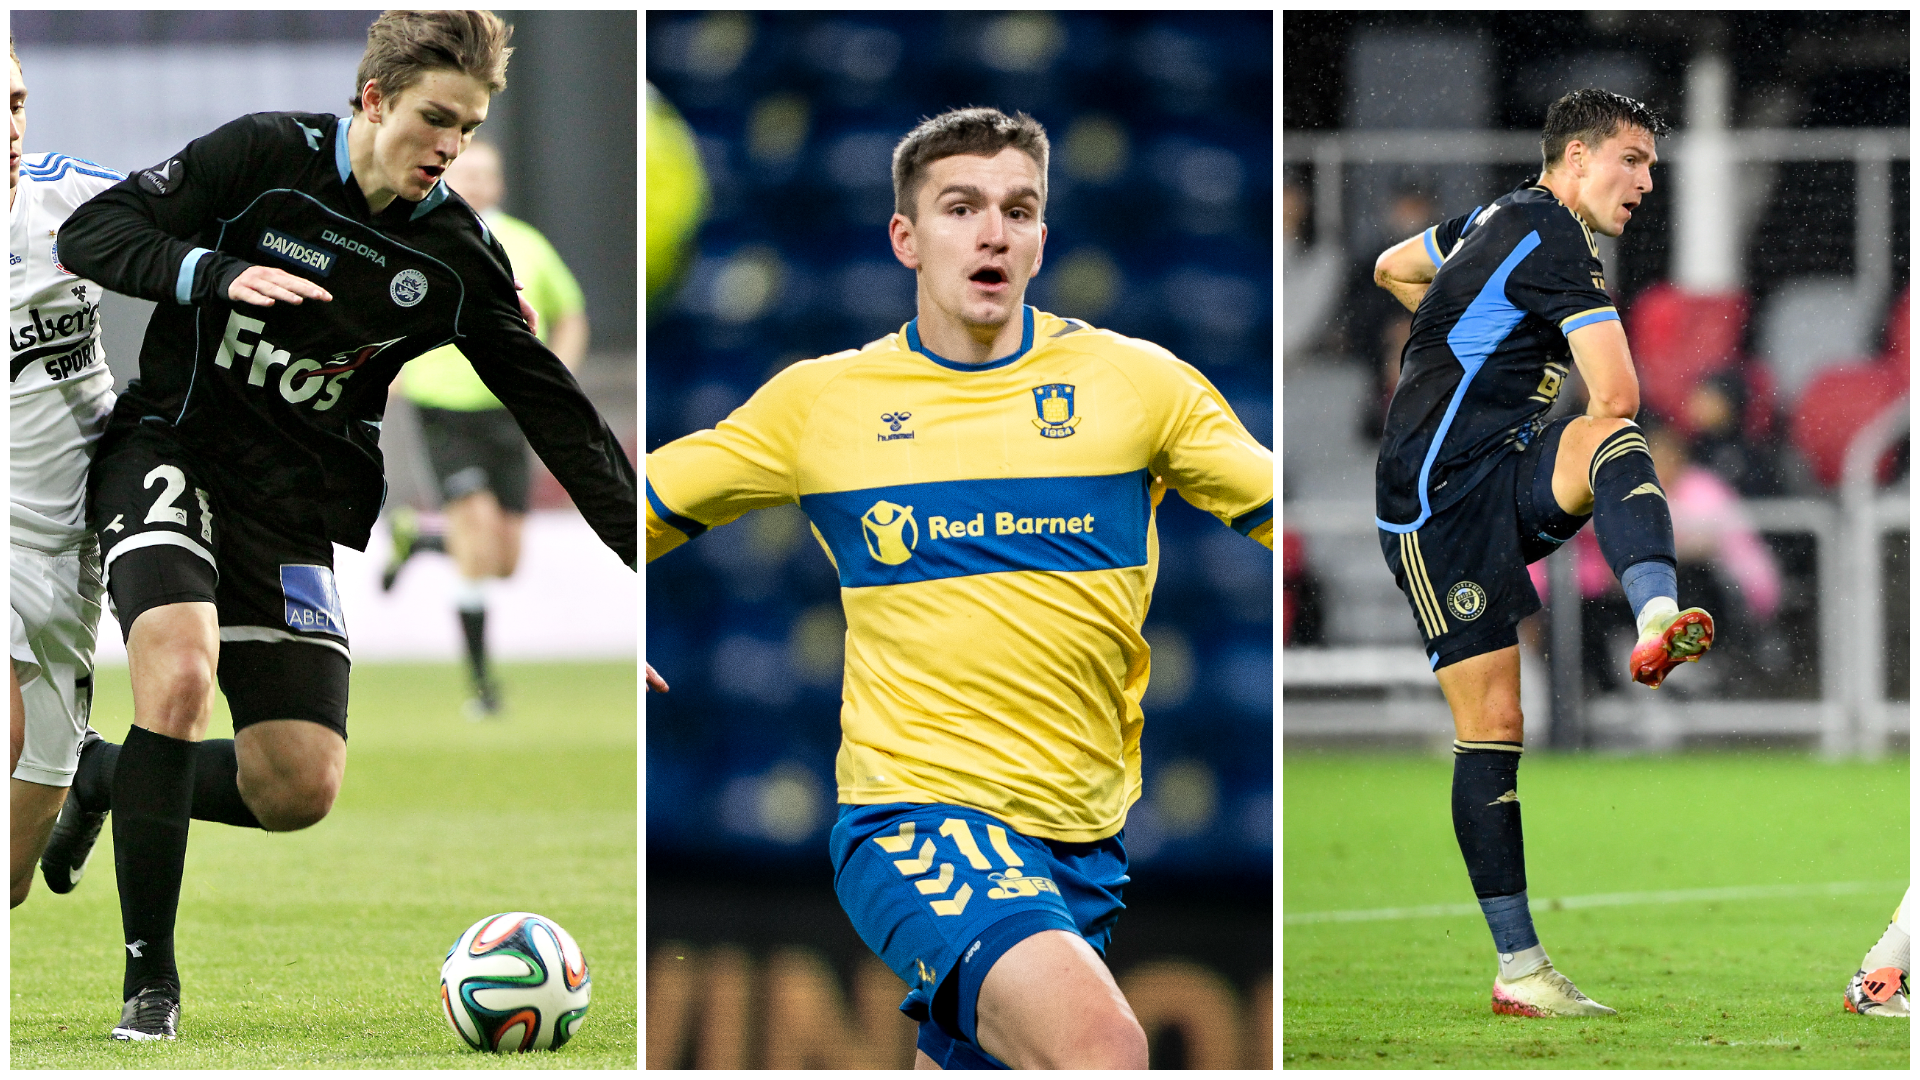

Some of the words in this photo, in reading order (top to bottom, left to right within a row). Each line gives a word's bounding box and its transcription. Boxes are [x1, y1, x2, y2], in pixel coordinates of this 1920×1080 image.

[262, 232, 331, 271] DAVIDSEN
[320, 229, 386, 268] DIADORA
[45, 339, 97, 380] SPORT
[214, 308, 355, 411] Fros
[1044, 427, 1072, 438] 1964
[928, 512, 985, 540] Red
[995, 511, 1095, 536] Barnet
